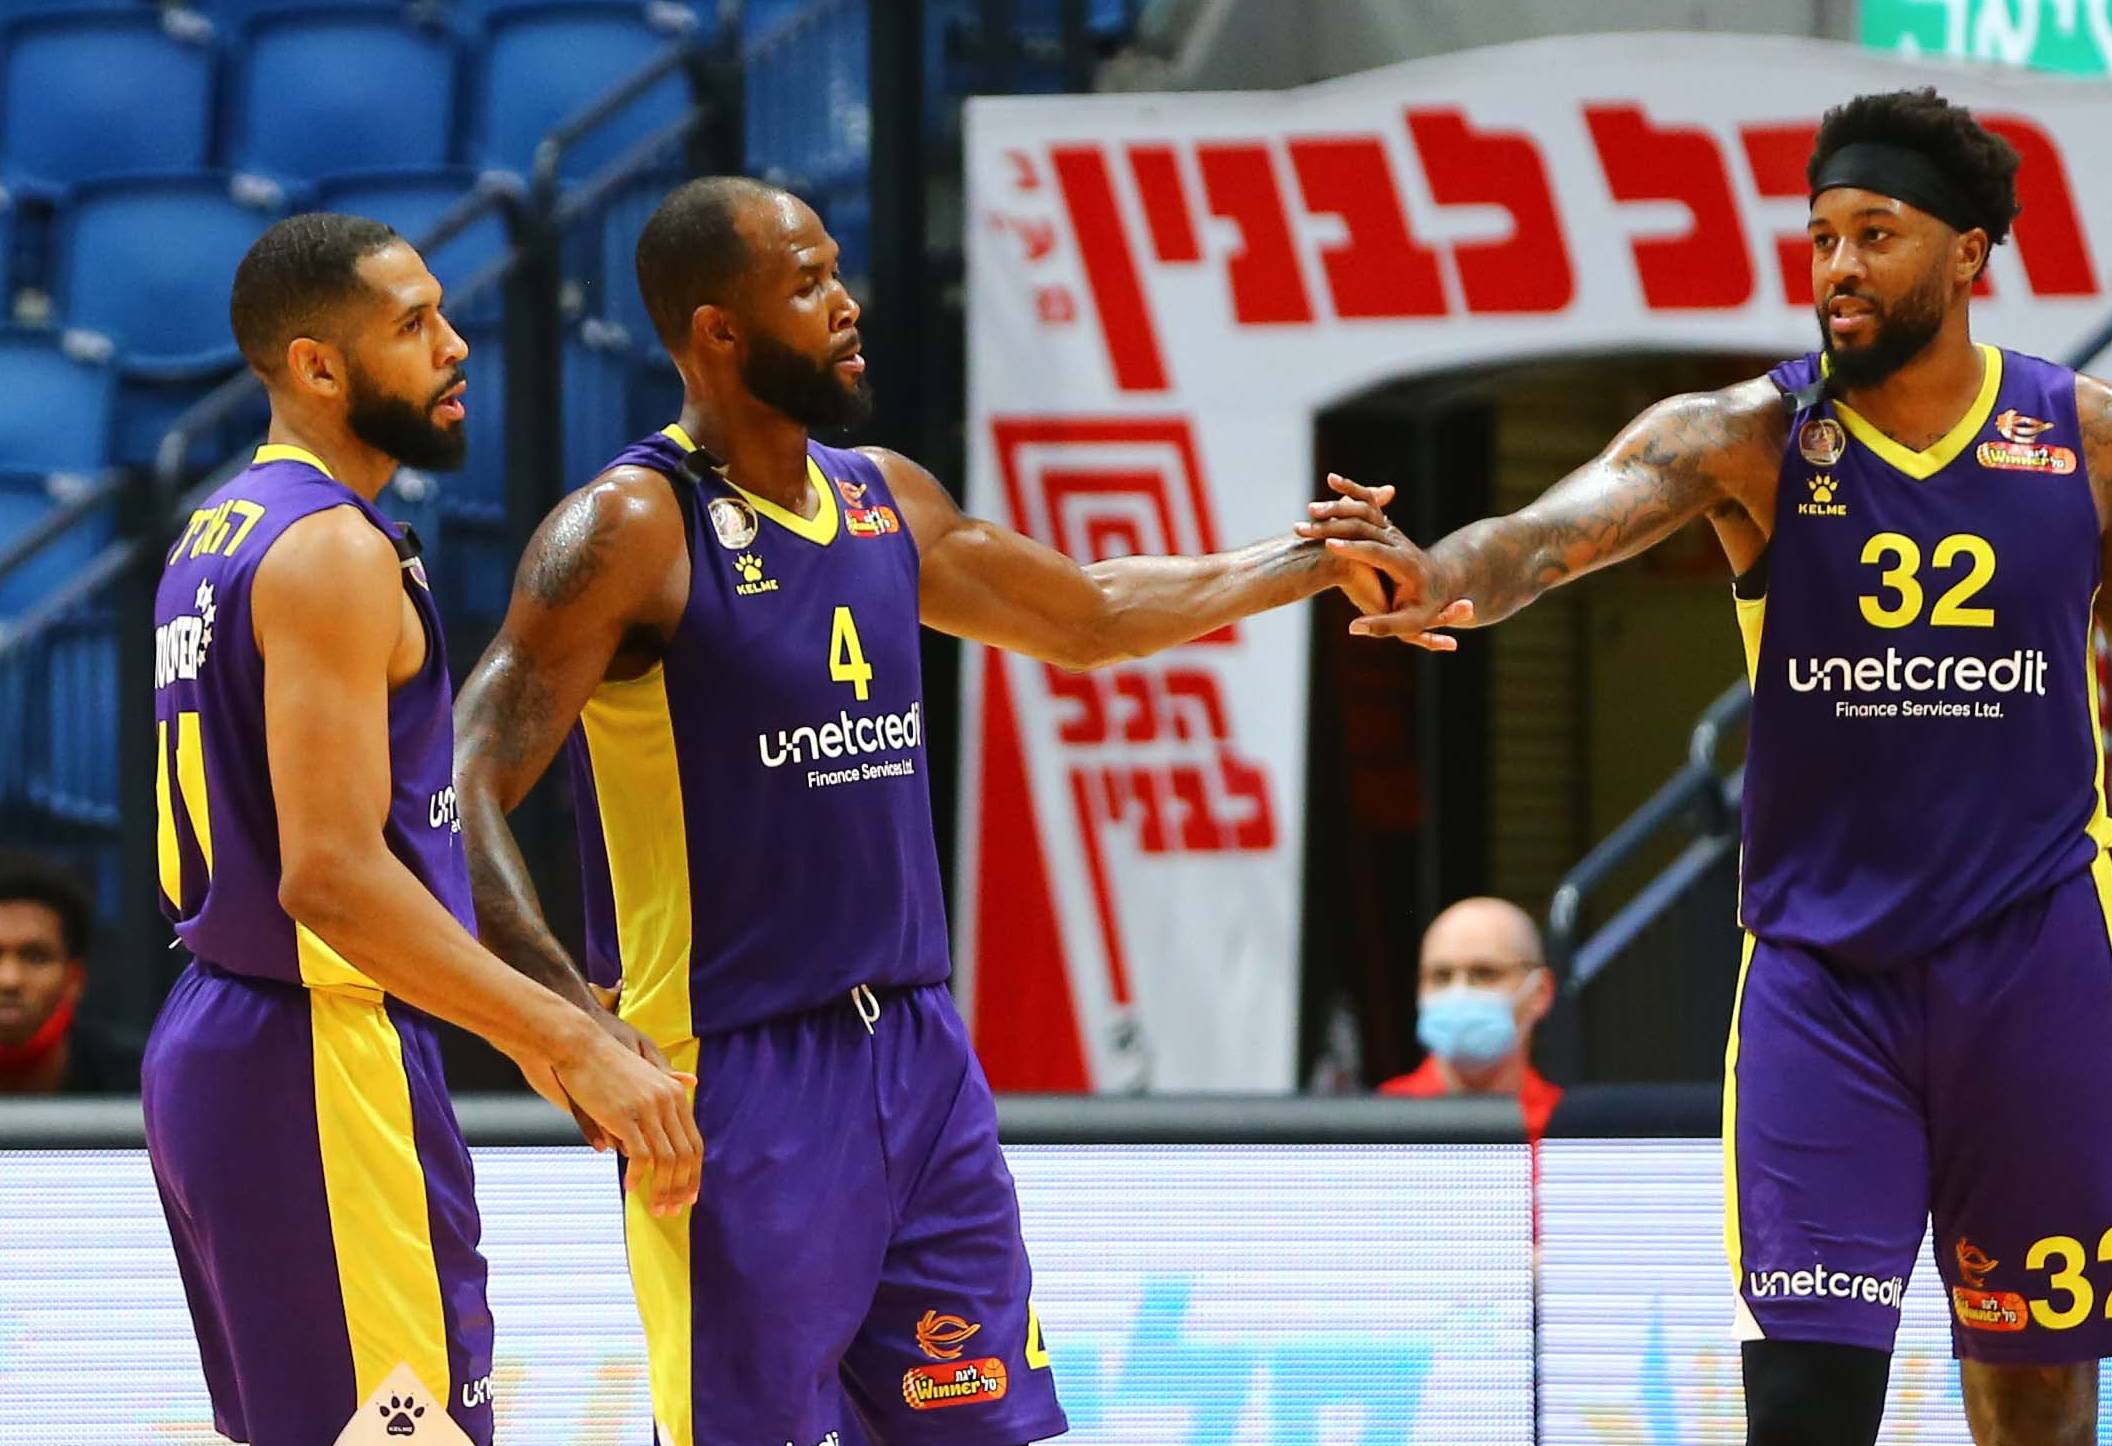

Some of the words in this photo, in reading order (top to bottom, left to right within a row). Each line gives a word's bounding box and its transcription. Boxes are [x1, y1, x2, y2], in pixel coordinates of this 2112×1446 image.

[1048, 105, 1575, 392] לבנין
[1798, 503, 1847, 516] KELME
[736, 579, 779, 595] KELME
[1858, 532, 1997, 629] 32
[829, 606, 873, 700] 4
[1788, 647, 2048, 696] unetcredit
[1836, 701, 1898, 717] Finance
[1902, 701, 1971, 718] Services
[1975, 702, 2004, 718] Ltd.
[759, 702, 922, 768] unetcredi
[808, 767, 860, 787] Finance
[861, 761, 903, 779] Services
[1750, 1264, 1903, 1310] unetcredit
[2026, 1226, 2112, 1330] 3
[914, 1377, 980, 1400] Winner
[980, 1375, 997, 1391] סל
